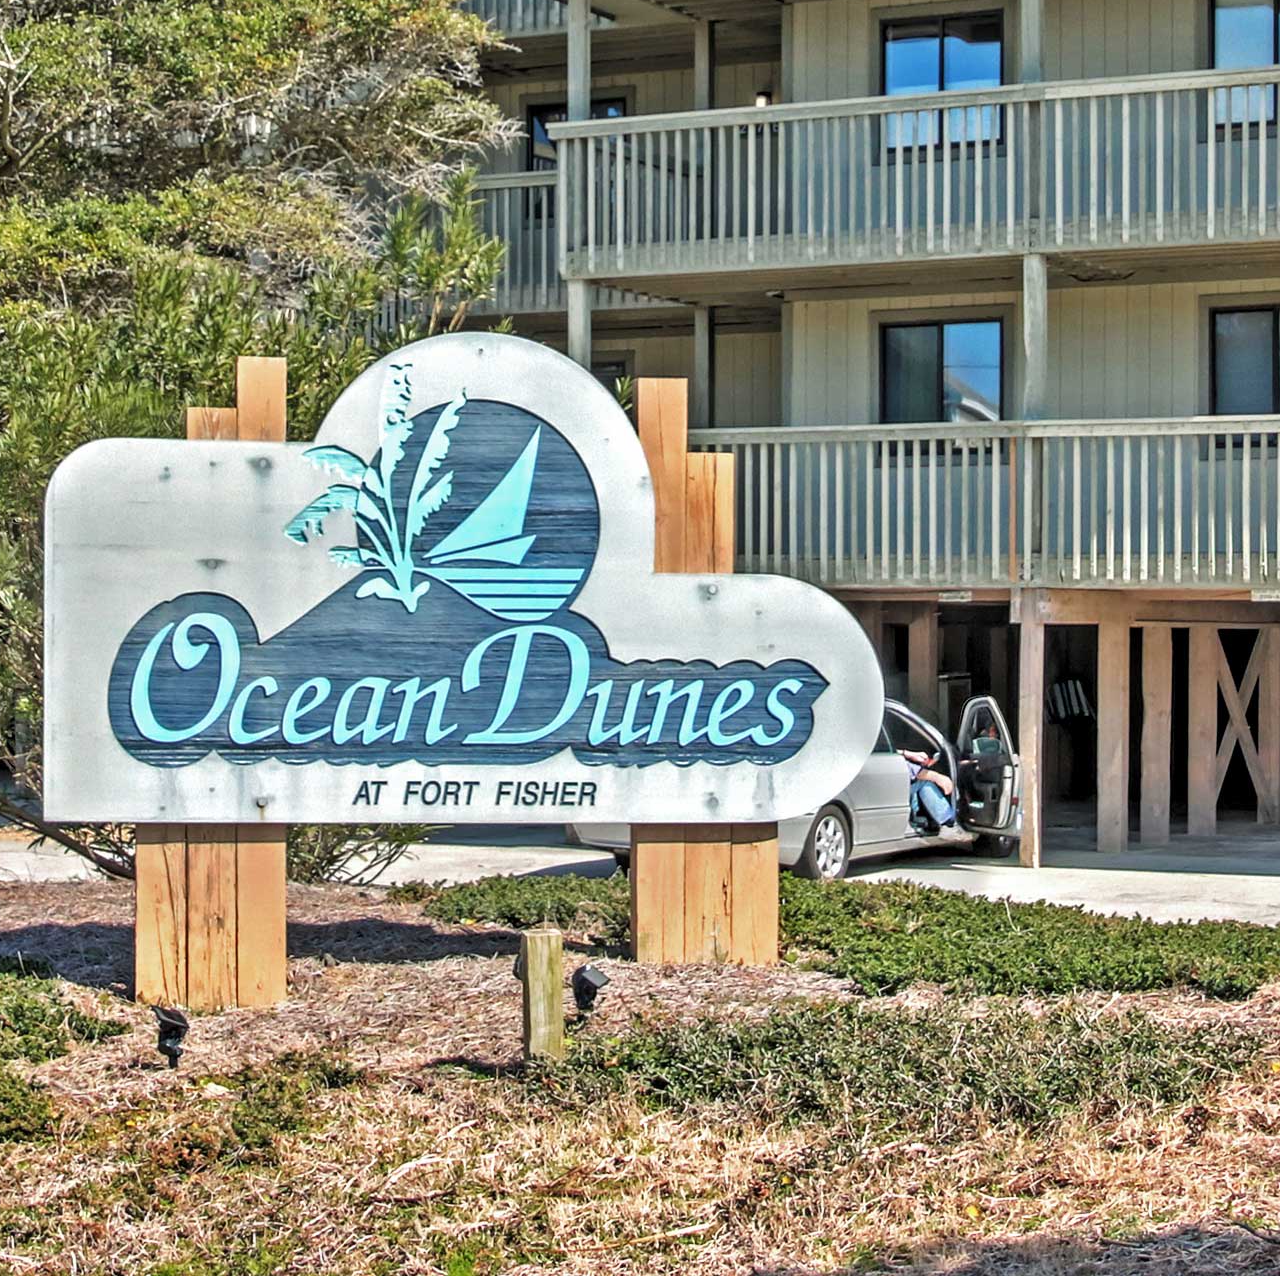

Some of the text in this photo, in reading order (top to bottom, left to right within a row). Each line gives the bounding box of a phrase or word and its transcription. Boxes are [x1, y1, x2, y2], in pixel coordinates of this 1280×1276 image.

[129, 612, 804, 745] Ocean Dunes
[352, 780, 597, 806] AT FORT FISHER
